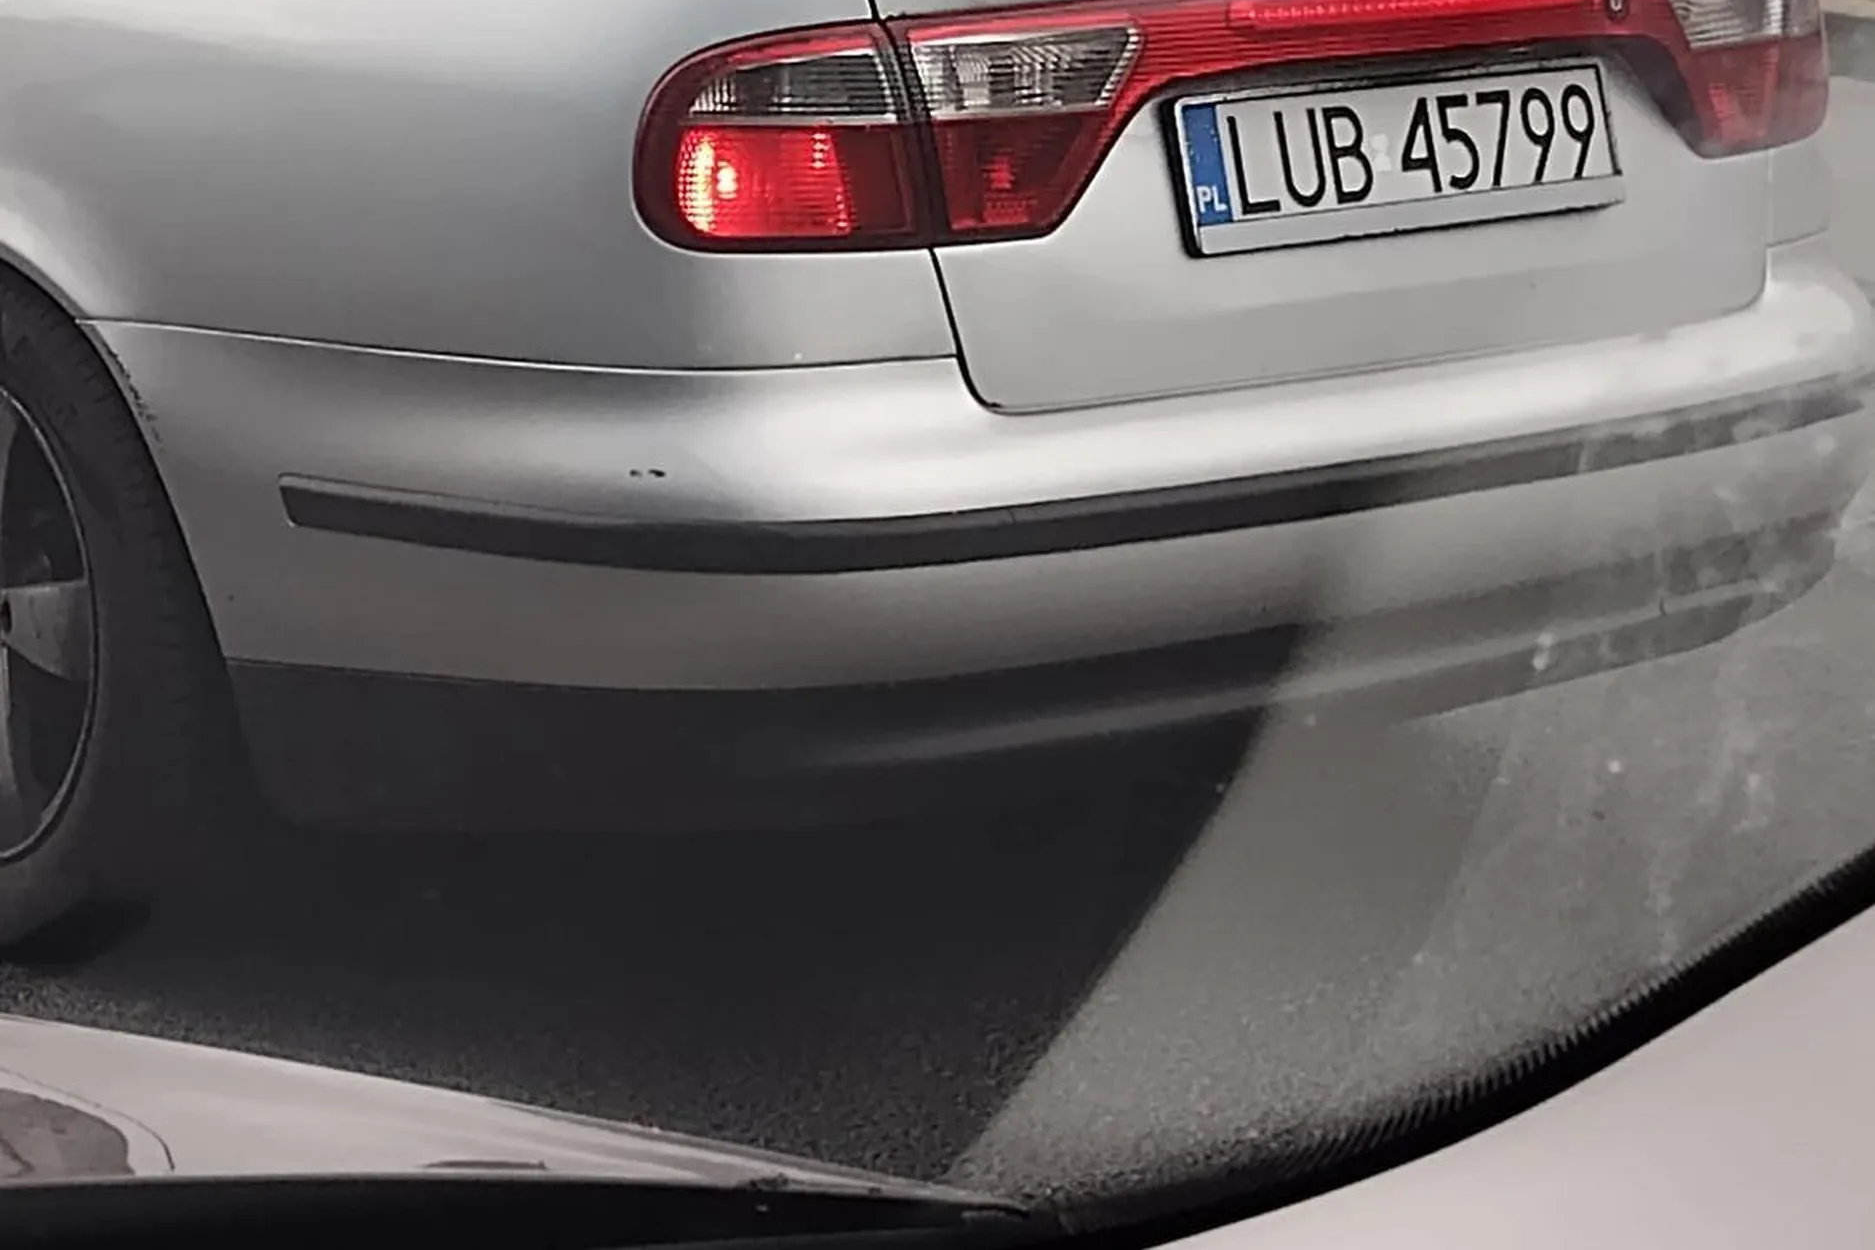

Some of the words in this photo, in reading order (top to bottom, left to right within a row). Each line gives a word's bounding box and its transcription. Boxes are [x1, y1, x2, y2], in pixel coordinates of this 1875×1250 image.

[1226, 105, 1374, 215] LUB
[1401, 83, 1597, 193] 45799
[1196, 185, 1228, 214] PL
